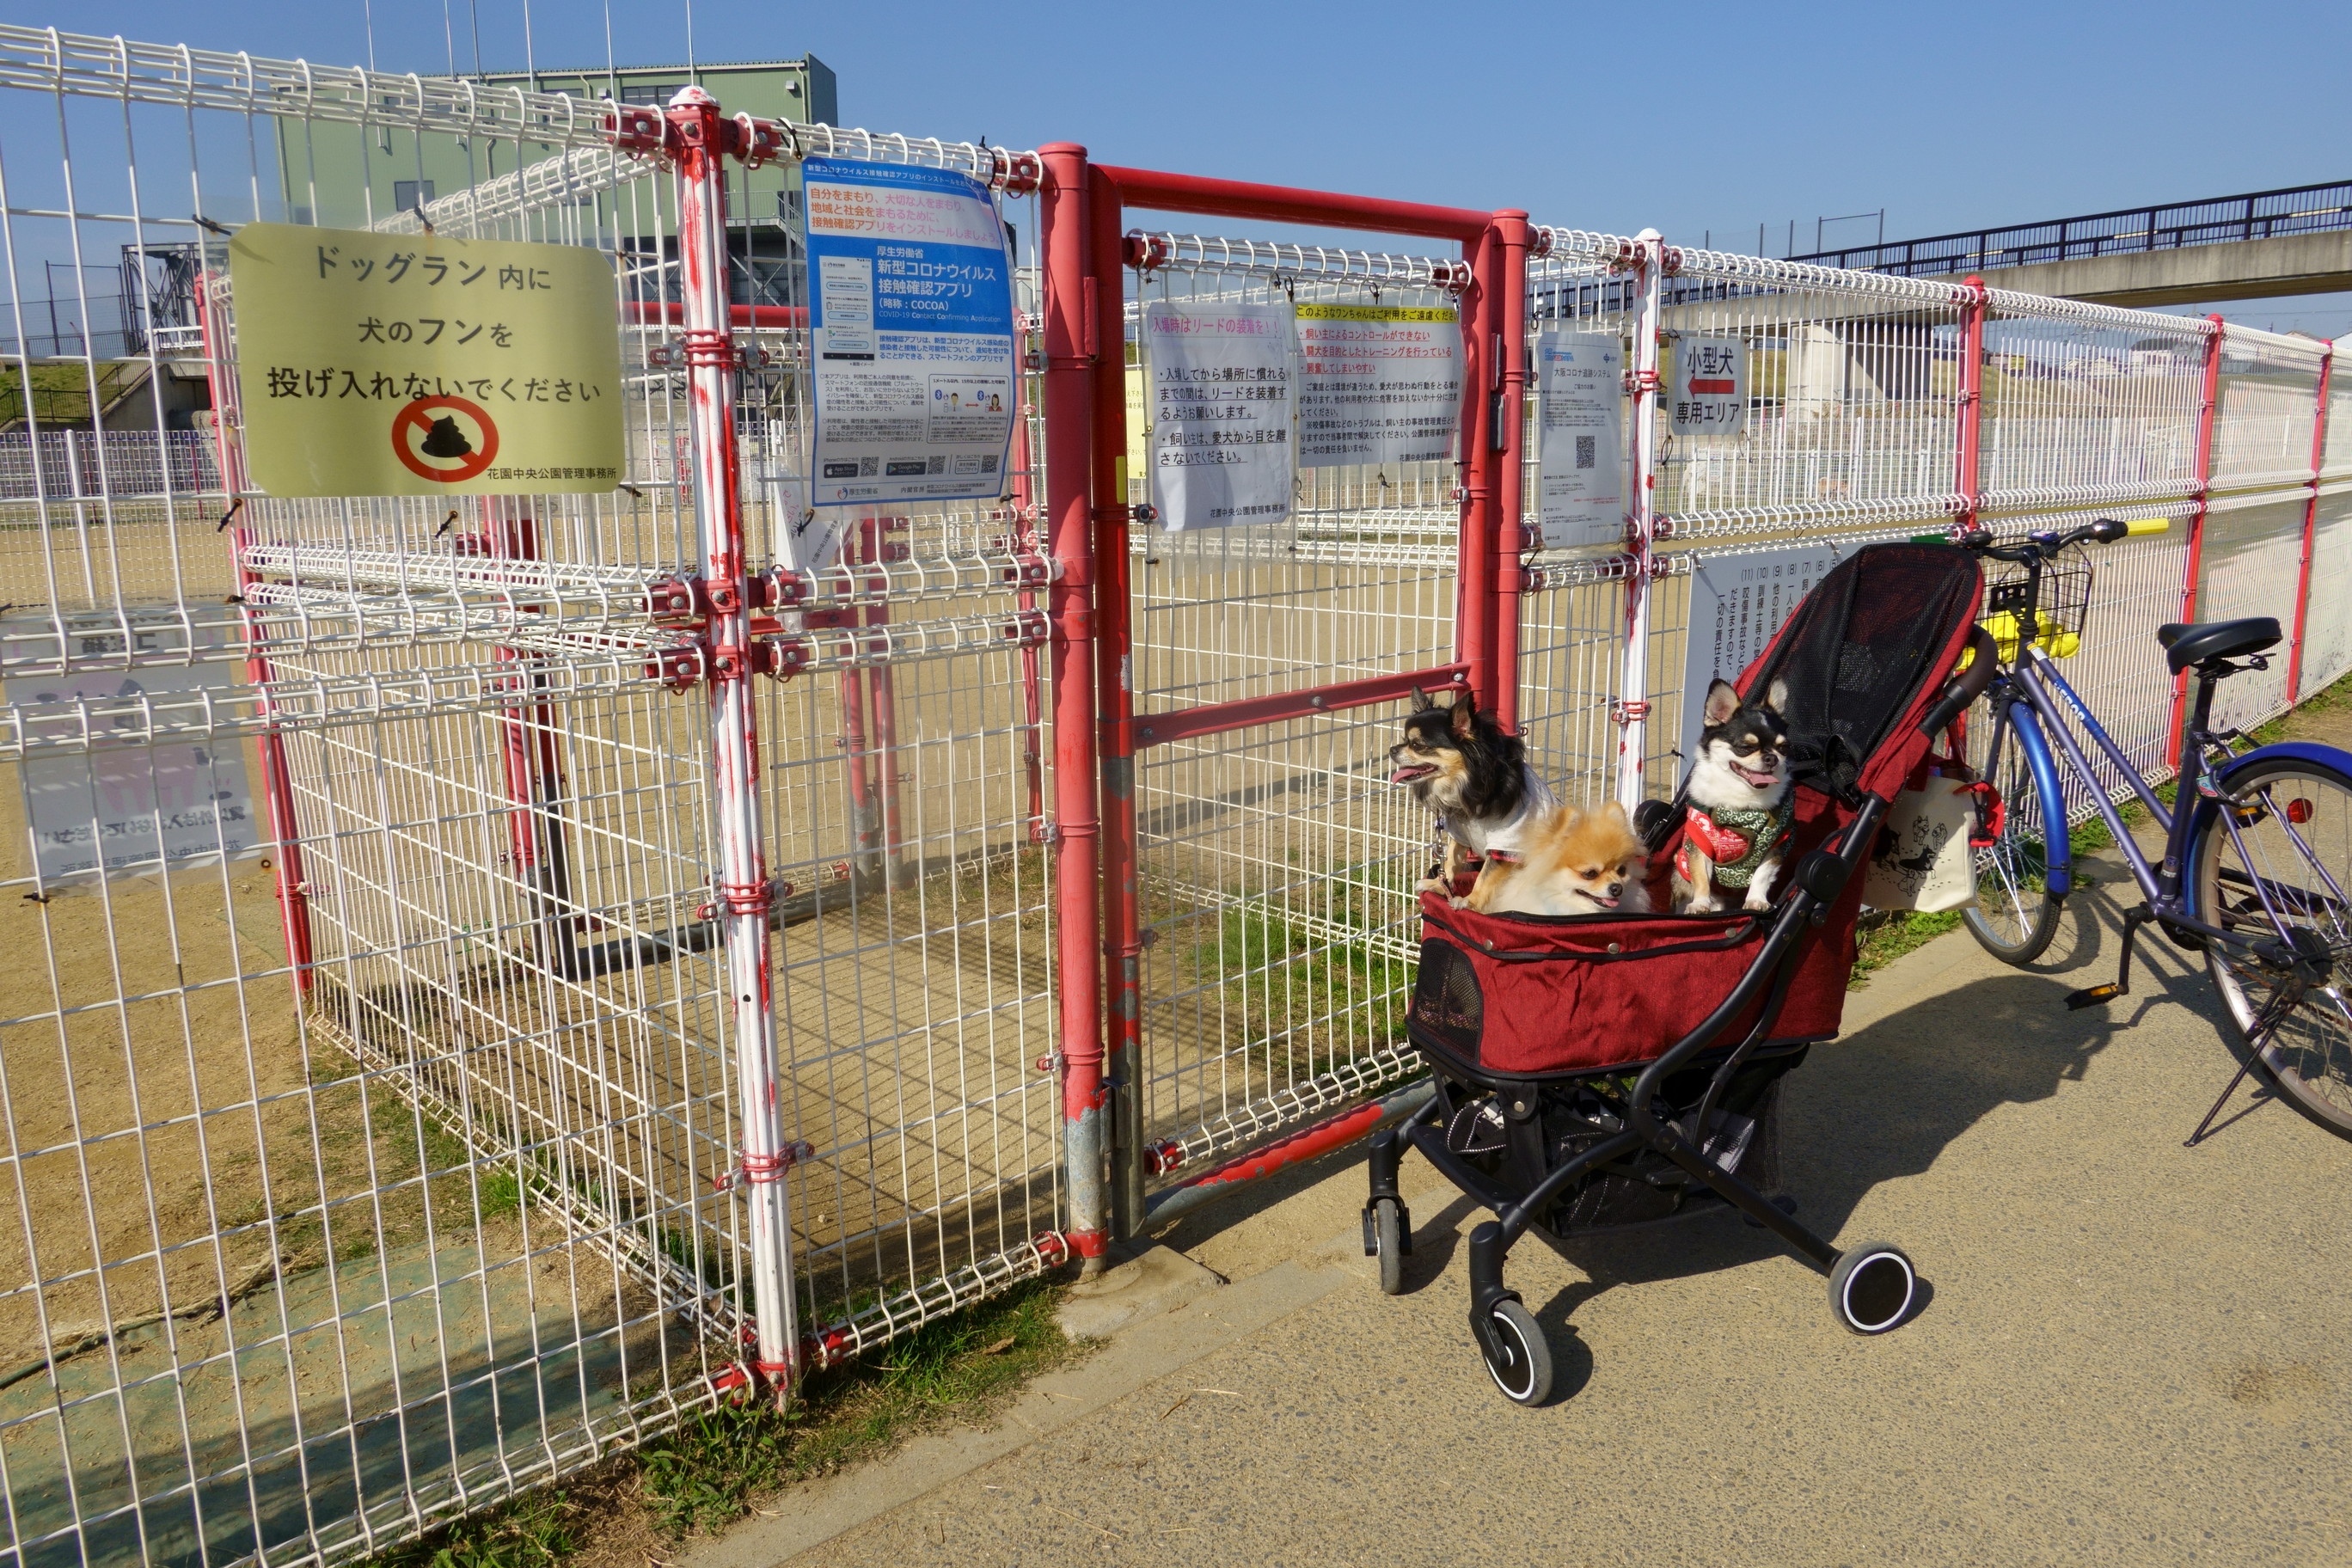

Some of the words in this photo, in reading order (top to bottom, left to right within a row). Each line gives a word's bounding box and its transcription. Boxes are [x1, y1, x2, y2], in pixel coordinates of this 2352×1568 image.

[811, 188, 966, 211] 自分をまもり、大切な人をまもり、
[812, 202, 940, 222] 地域と社会をまもるために、
[812, 217, 1000, 242] 接触確認アプリをインストールしましょう。
[877, 246, 923, 258] 厚生労働省
[318, 246, 552, 291] ドッグラン内に
[878, 260, 996, 281] 新型コロナウイルス
[879, 279, 972, 297] 接触確認アプリ
[879, 299, 949, 311] （略称：COCOA）
[936, 314, 970, 322] Confirming
[1154, 315, 1279, 335] 入場時はリードの装着を！！
[358, 316, 513, 348] 犬のフンを
[1687, 346, 1734, 376] 小型犬
[1554, 368, 1611, 378] 大阪コロナ追跡システム
[268, 367, 601, 403] 投げ入れないでください
[1161, 387, 1287, 401] までの間は、リードを装着す
[1161, 406, 1253, 420] るようお願いします。
[1301, 407, 1338, 417] してください。
[1675, 401, 1740, 424] 専用エリア
[1161, 450, 1243, 467] さないでください。
[487, 467, 617, 481] 花園中央公園管理事務所
[849, 487, 879, 496] 厚生労働省
[1210, 504, 1286, 519] 花園中央公園管理事務所
[1724, 588, 1738, 685] だきますので、
